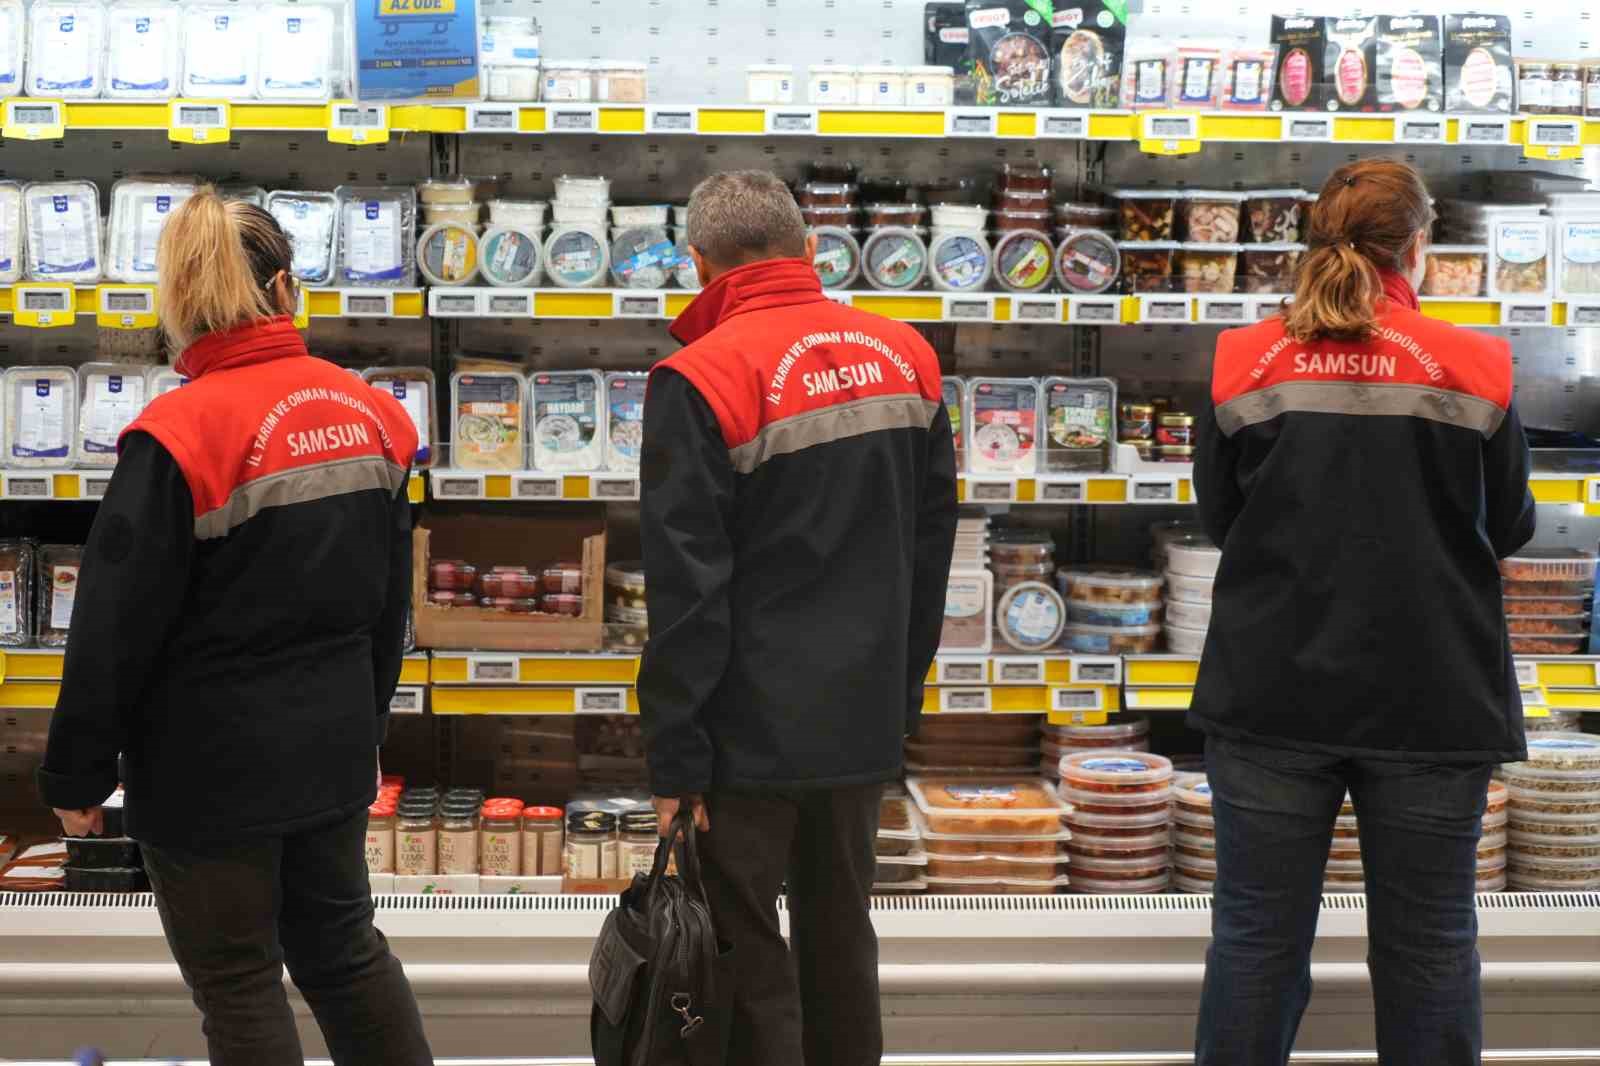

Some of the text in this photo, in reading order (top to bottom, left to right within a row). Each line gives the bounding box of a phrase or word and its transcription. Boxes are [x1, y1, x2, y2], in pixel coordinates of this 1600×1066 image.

[771, 353, 796, 390] TARIM
[788, 341, 807, 357] VE
[802, 331, 841, 349] ORMAN
[1293, 352, 1397, 377] SAMSUN
[802, 361, 883, 396] SAMSUN
[254, 412, 280, 450] TARIM
[272, 400, 292, 417] VE
[287, 387, 329, 407] ORMAN
[287, 422, 369, 457] SAMSUN
